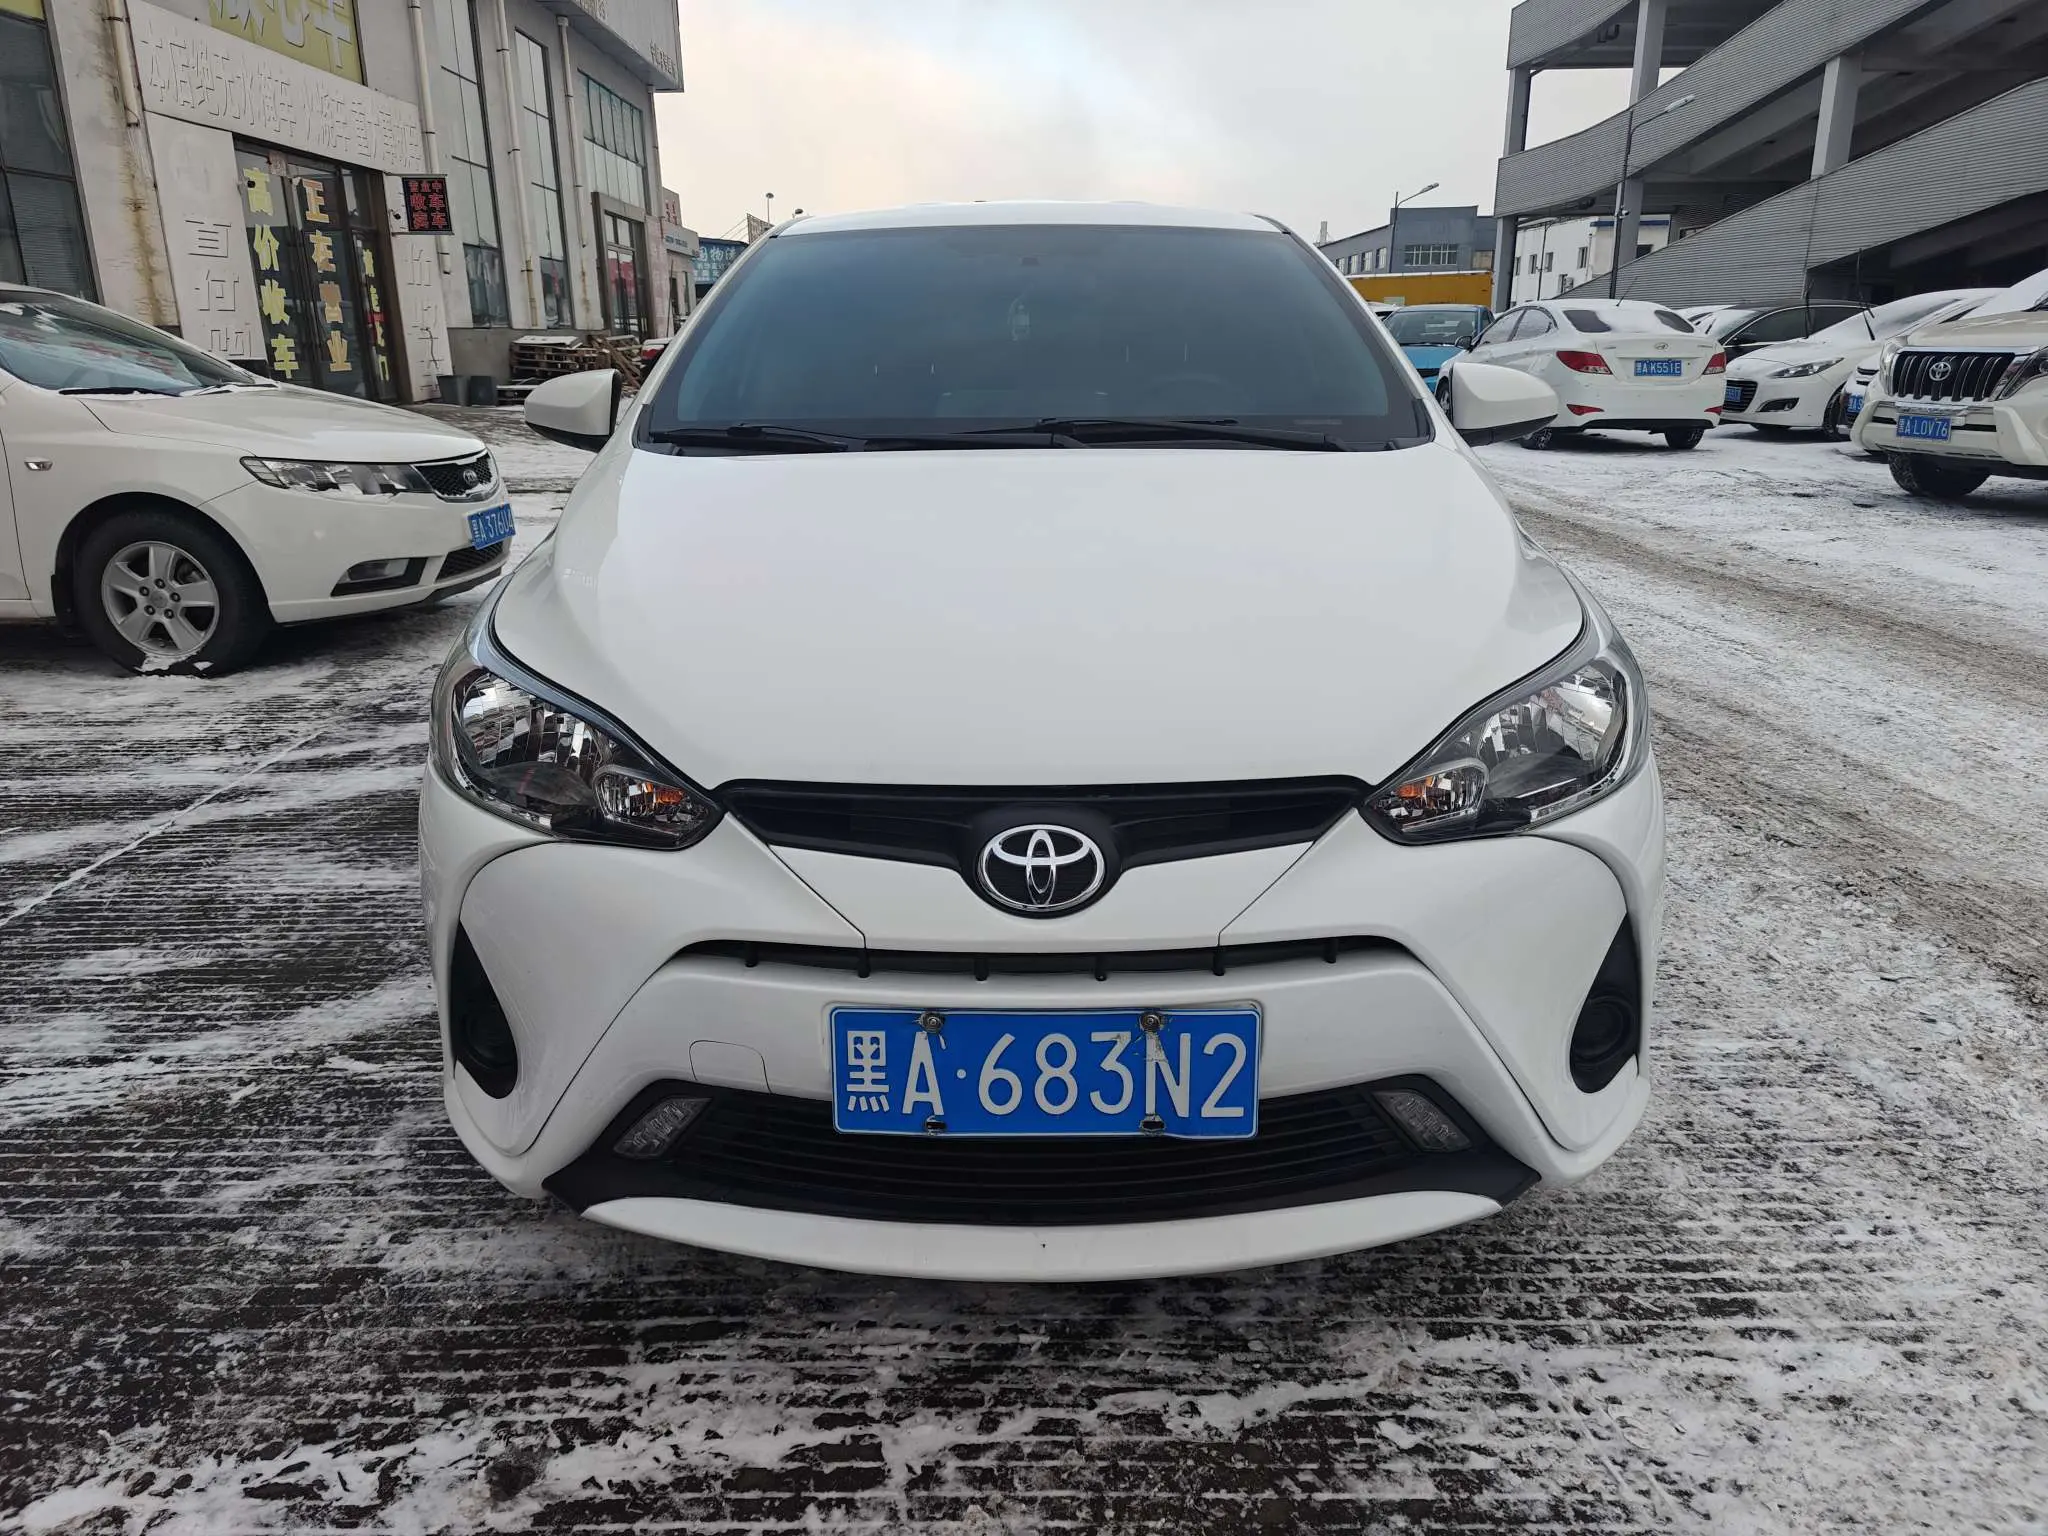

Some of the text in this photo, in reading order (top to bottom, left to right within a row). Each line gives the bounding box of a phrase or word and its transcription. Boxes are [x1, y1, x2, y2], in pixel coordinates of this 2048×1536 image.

[243, 166, 299, 379] 高价收车
[302, 178, 353, 373] 正在营业
[846, 1029, 1247, 1118] 黑A·683N2
